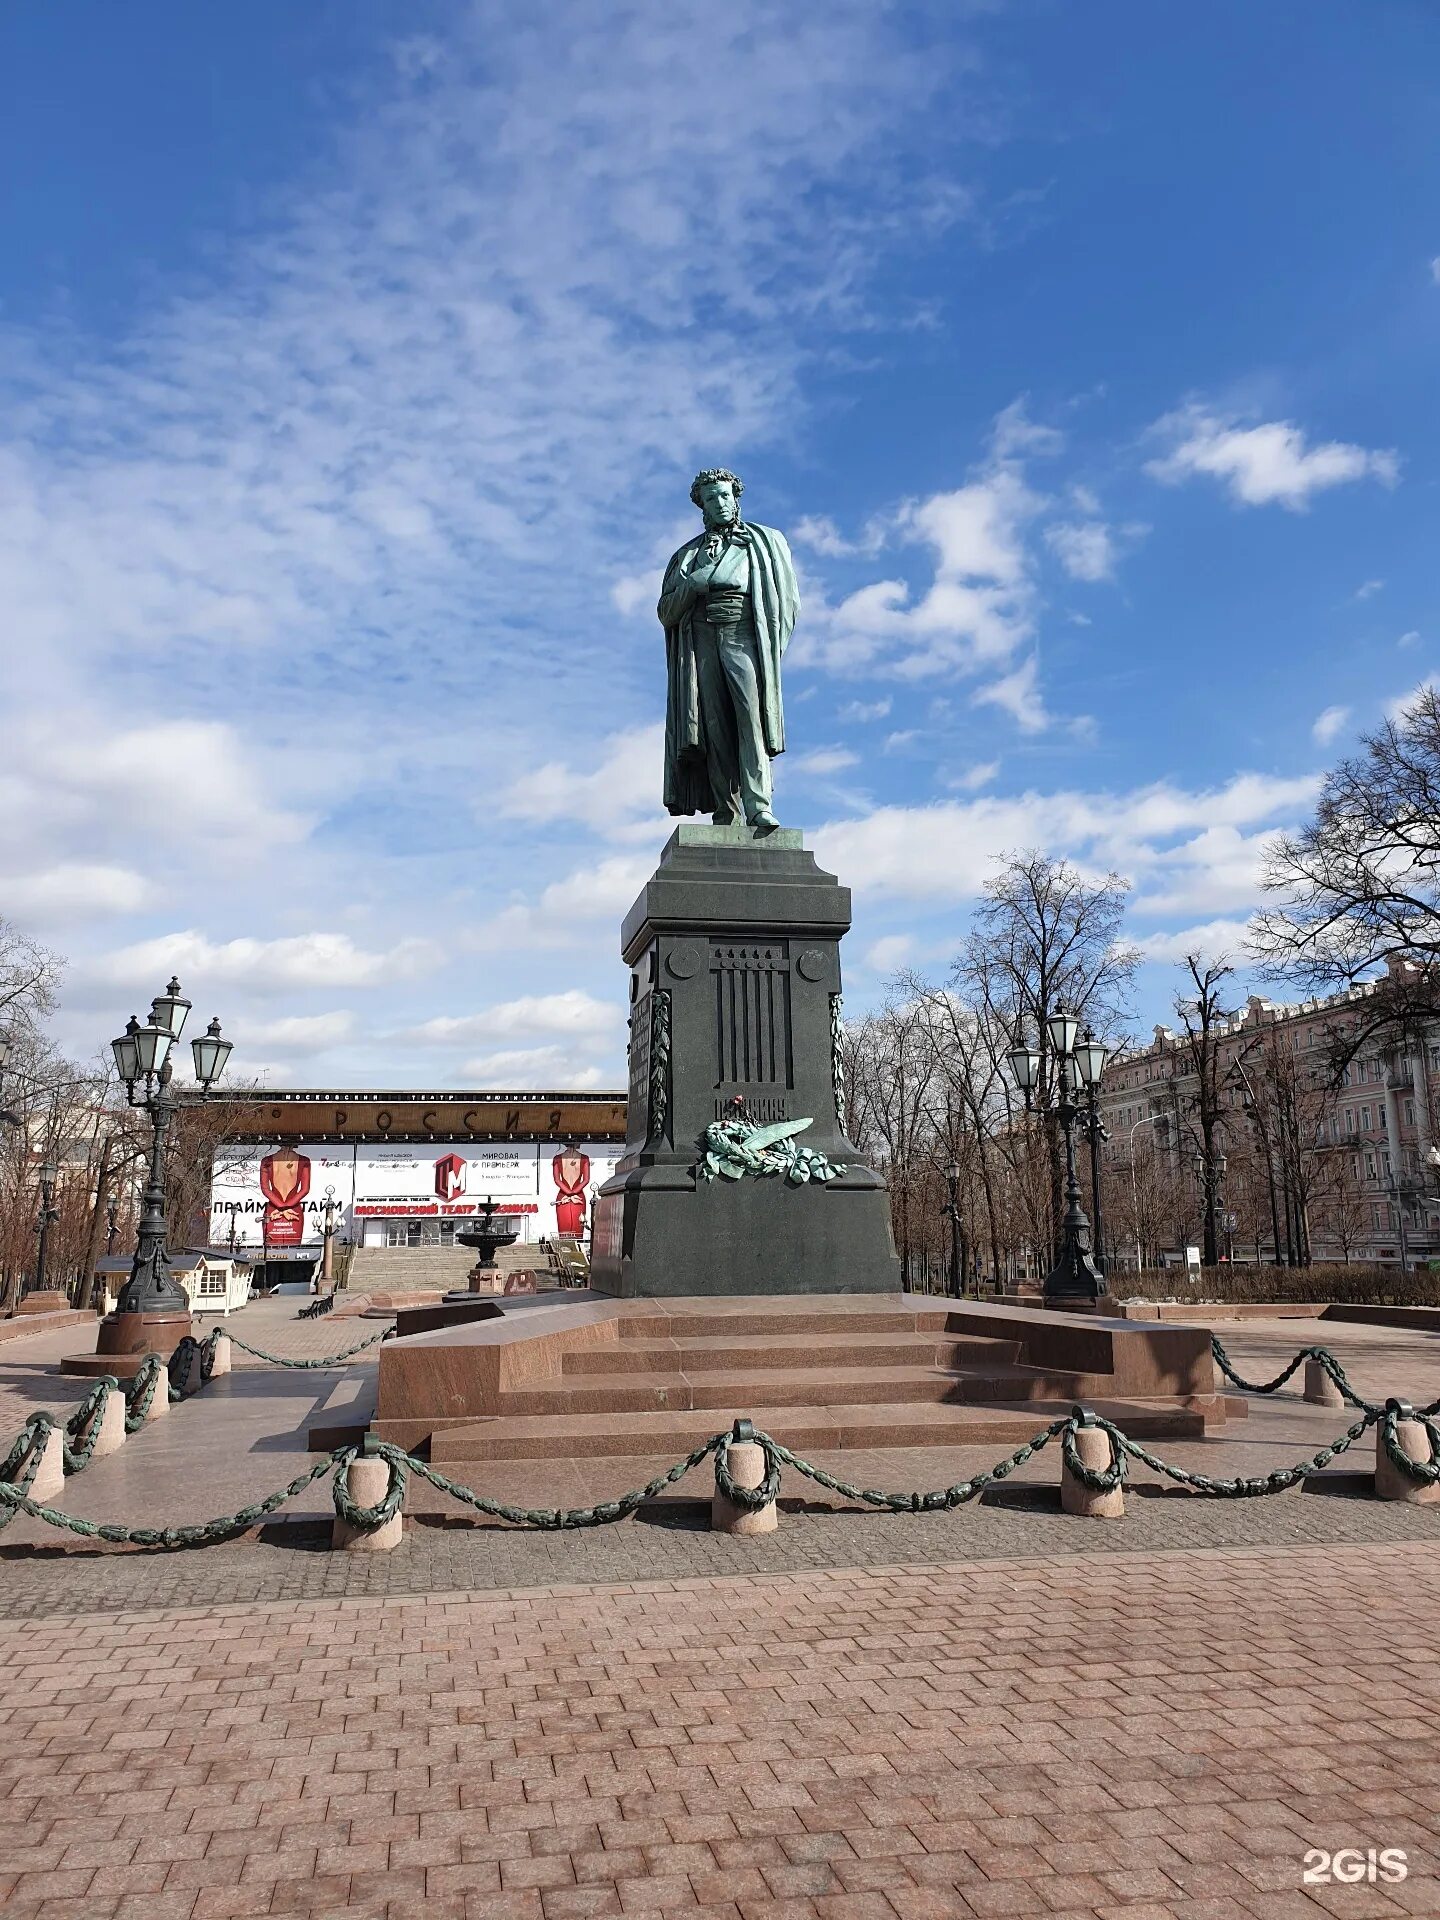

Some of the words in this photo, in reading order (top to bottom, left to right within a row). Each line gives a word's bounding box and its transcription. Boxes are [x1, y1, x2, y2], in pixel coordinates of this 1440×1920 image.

[335, 1110, 562, 1131] РОССИЯ
[481, 1152, 519, 1160] МИРОВАЯ
[213, 1198, 268, 1214] ПРАЙМ
[354, 1203, 439, 1215] МОСКОВСКИЙ
[440, 1203, 476, 1215] ТЕАТР
